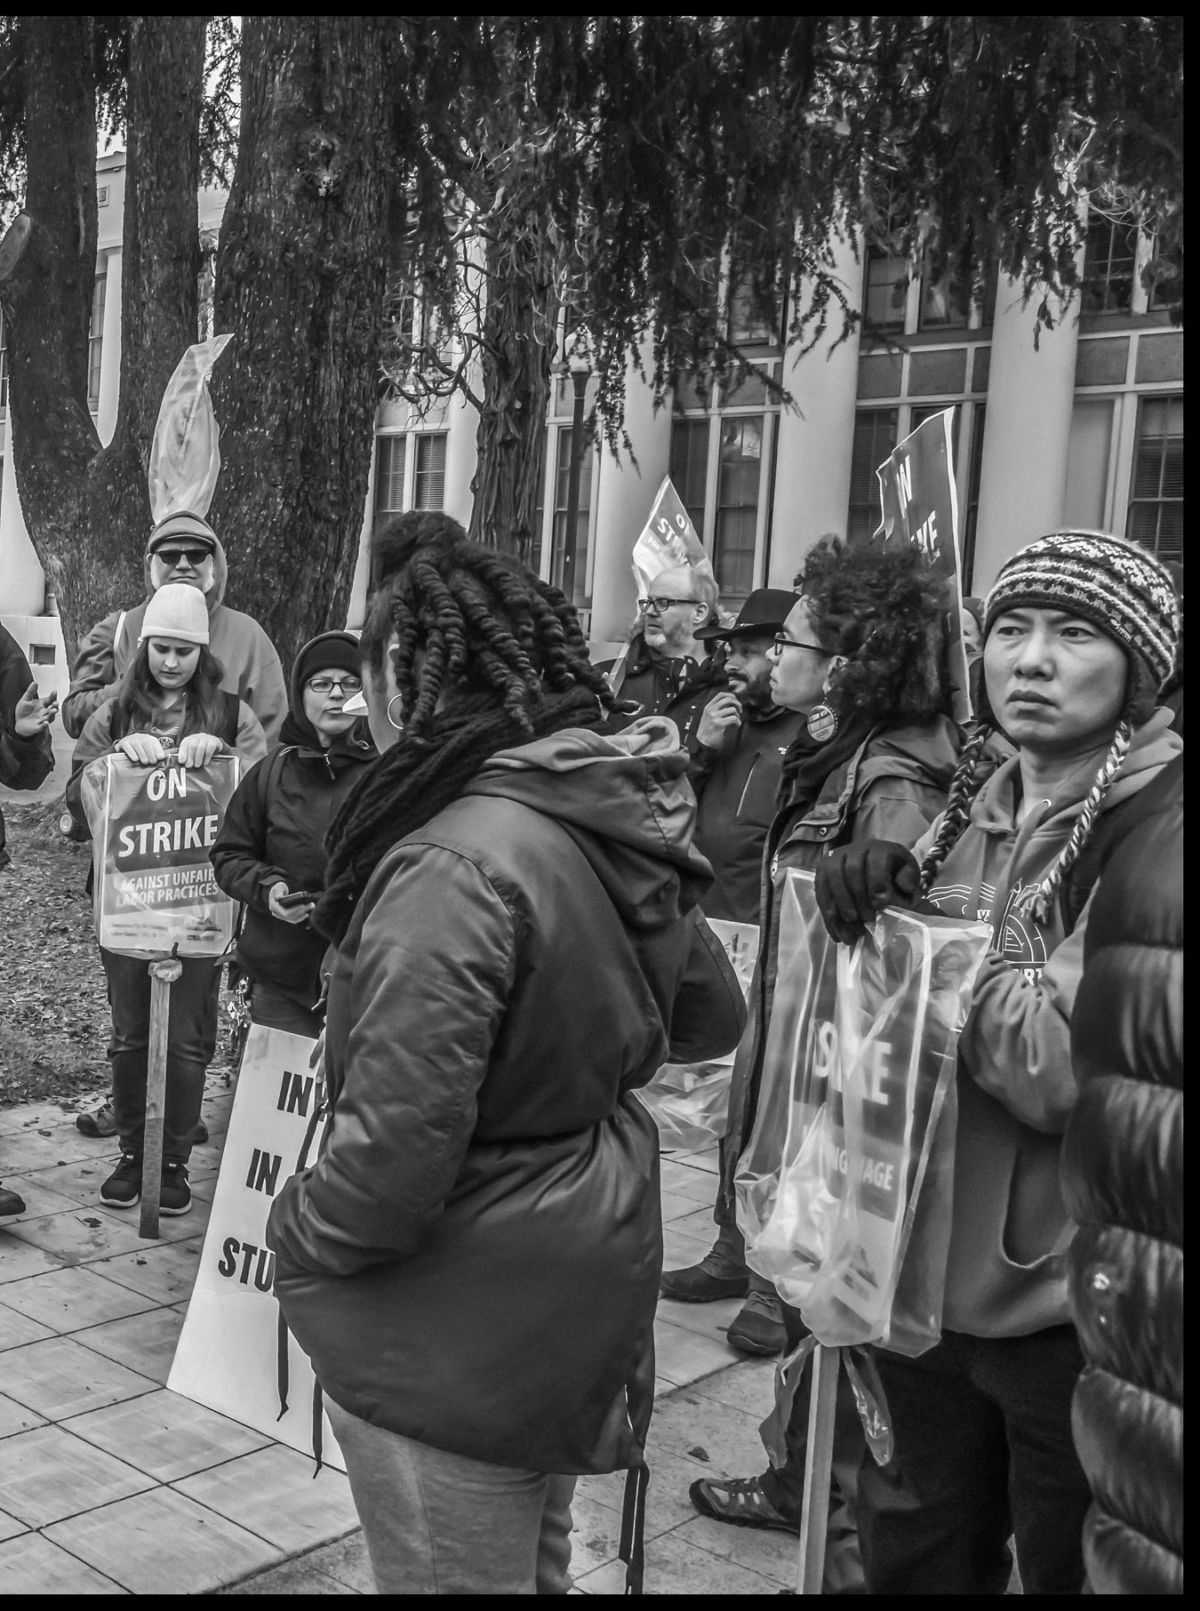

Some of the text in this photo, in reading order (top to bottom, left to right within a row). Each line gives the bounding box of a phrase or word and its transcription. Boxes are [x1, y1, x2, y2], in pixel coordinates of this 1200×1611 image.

[146, 767, 187, 801] ON
[118, 814, 219, 858] STRIKE
[158, 883, 220, 902] PRACTICES
[173, 868, 216, 886] UNFAIR
[277, 1071, 327, 1122] IN
[245, 1148, 282, 1198] IN
